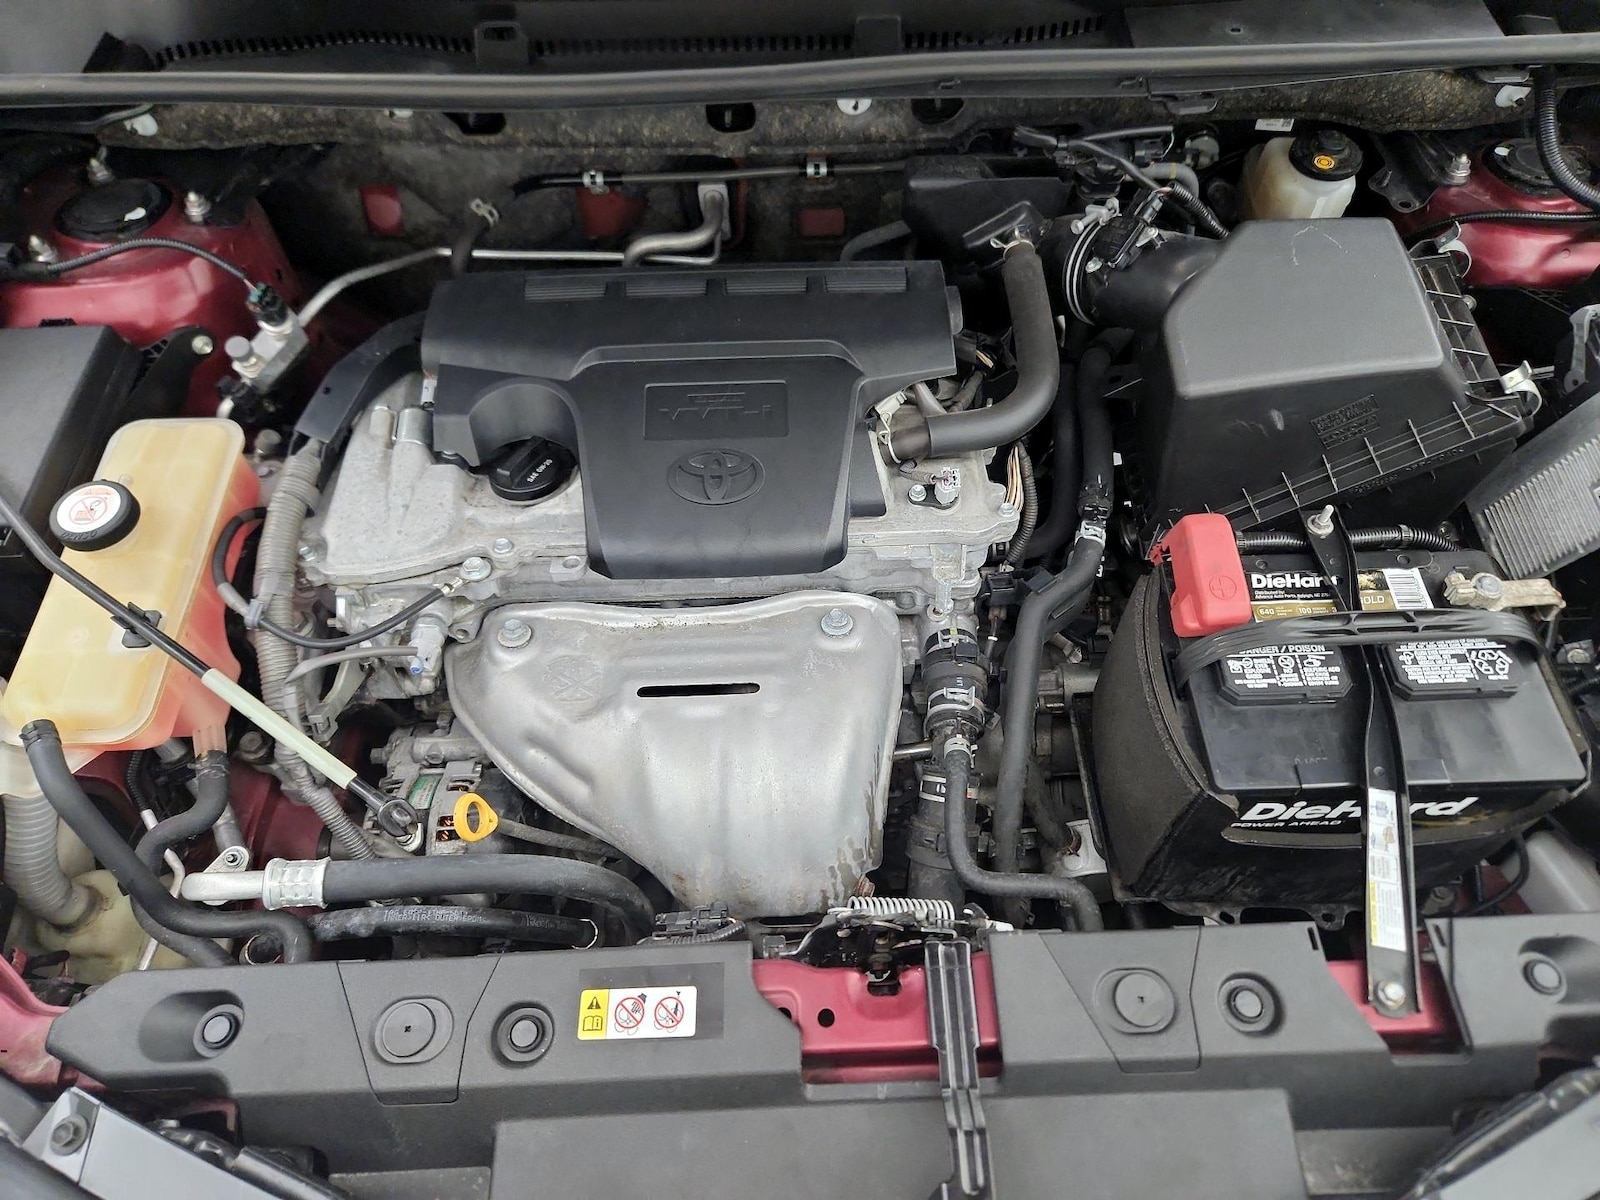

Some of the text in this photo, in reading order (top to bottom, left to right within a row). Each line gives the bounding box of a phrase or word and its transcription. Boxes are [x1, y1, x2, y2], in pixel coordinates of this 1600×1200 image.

[526, 471, 540, 483] SAE
[1361, 595, 1385, 604] OLD
[1258, 608, 1275, 616] 640
[1239, 645, 1279, 655] ANGER
[1288, 644, 1326, 653] POISON
[1230, 821, 1285, 829] POWER
